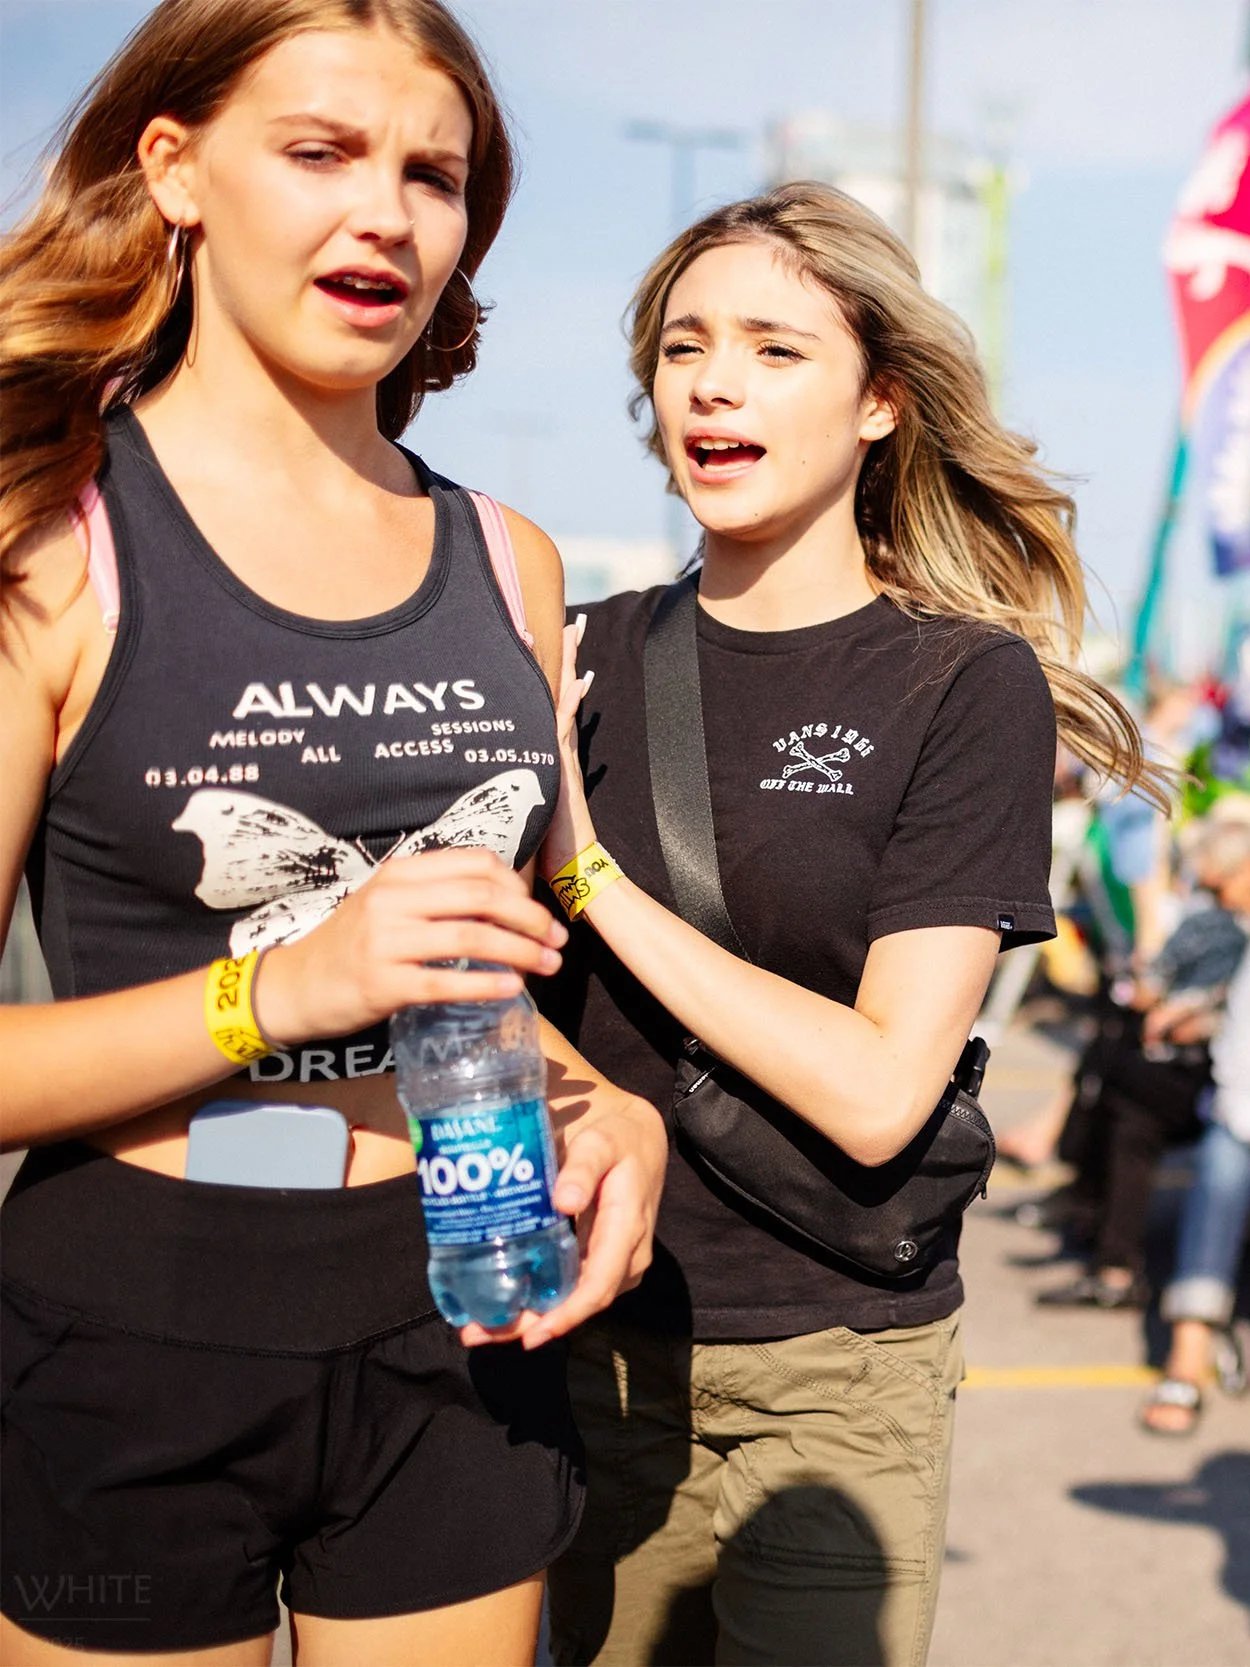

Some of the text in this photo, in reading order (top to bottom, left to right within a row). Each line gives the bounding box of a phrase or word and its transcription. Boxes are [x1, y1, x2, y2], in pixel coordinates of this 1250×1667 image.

[232, 679, 486, 719] ALWAYS
[209, 719, 515, 749] MELODY SESSIONS
[301, 739, 454, 764] ALL ACCESS
[145, 748, 555, 787] 03.04.88 03.05.1970
[787, 781, 814, 793] THE
[816, 783, 854, 795] WALL
[217, 955, 248, 1012] 202
[417, 1143, 535, 1196] 100%
